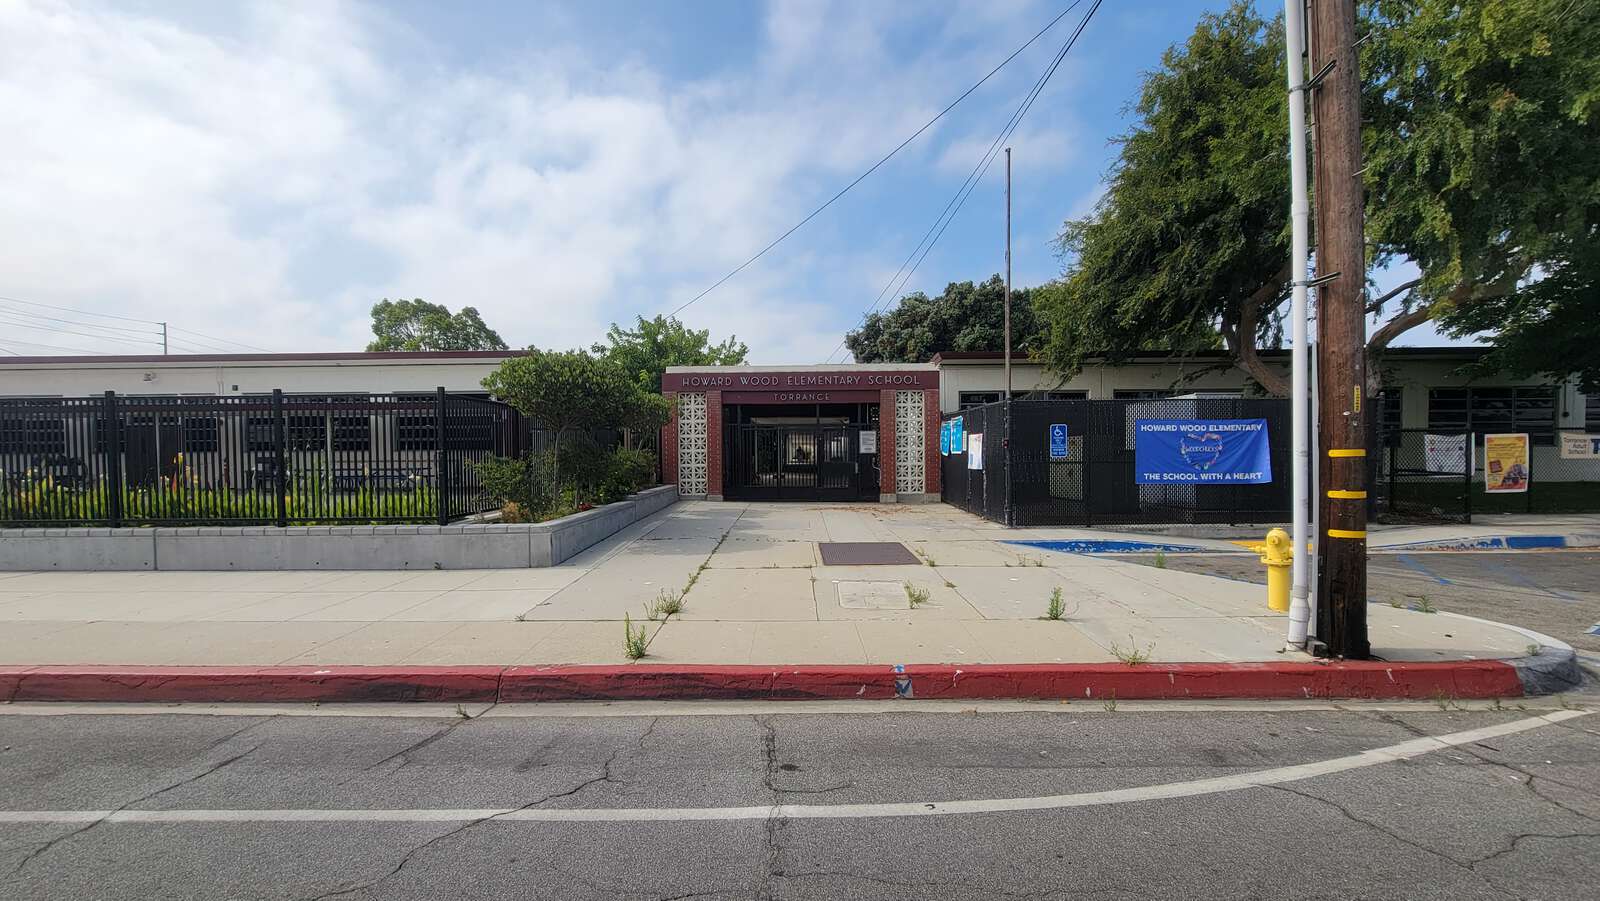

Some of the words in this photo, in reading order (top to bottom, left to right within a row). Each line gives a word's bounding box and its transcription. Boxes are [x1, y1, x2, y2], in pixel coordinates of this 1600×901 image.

[682, 377, 732, 387] HOWARD
[740, 376, 779, 386] WOOD
[787, 375, 861, 386] ELEMENTARY
[868, 374, 921, 386] SCHOOL
[774, 392, 831, 401] TORRANCE
[1140, 424, 1178, 432] HOWARD
[1180, 424, 1207, 432] WOOD
[1209, 423, 1263, 432] ELEMENTARY
[1163, 472, 1199, 481] SCHOOL
[1200, 472, 1223, 480] WITH
[1225, 472, 1232, 480] A
[1233, 472, 1263, 480] HEART
